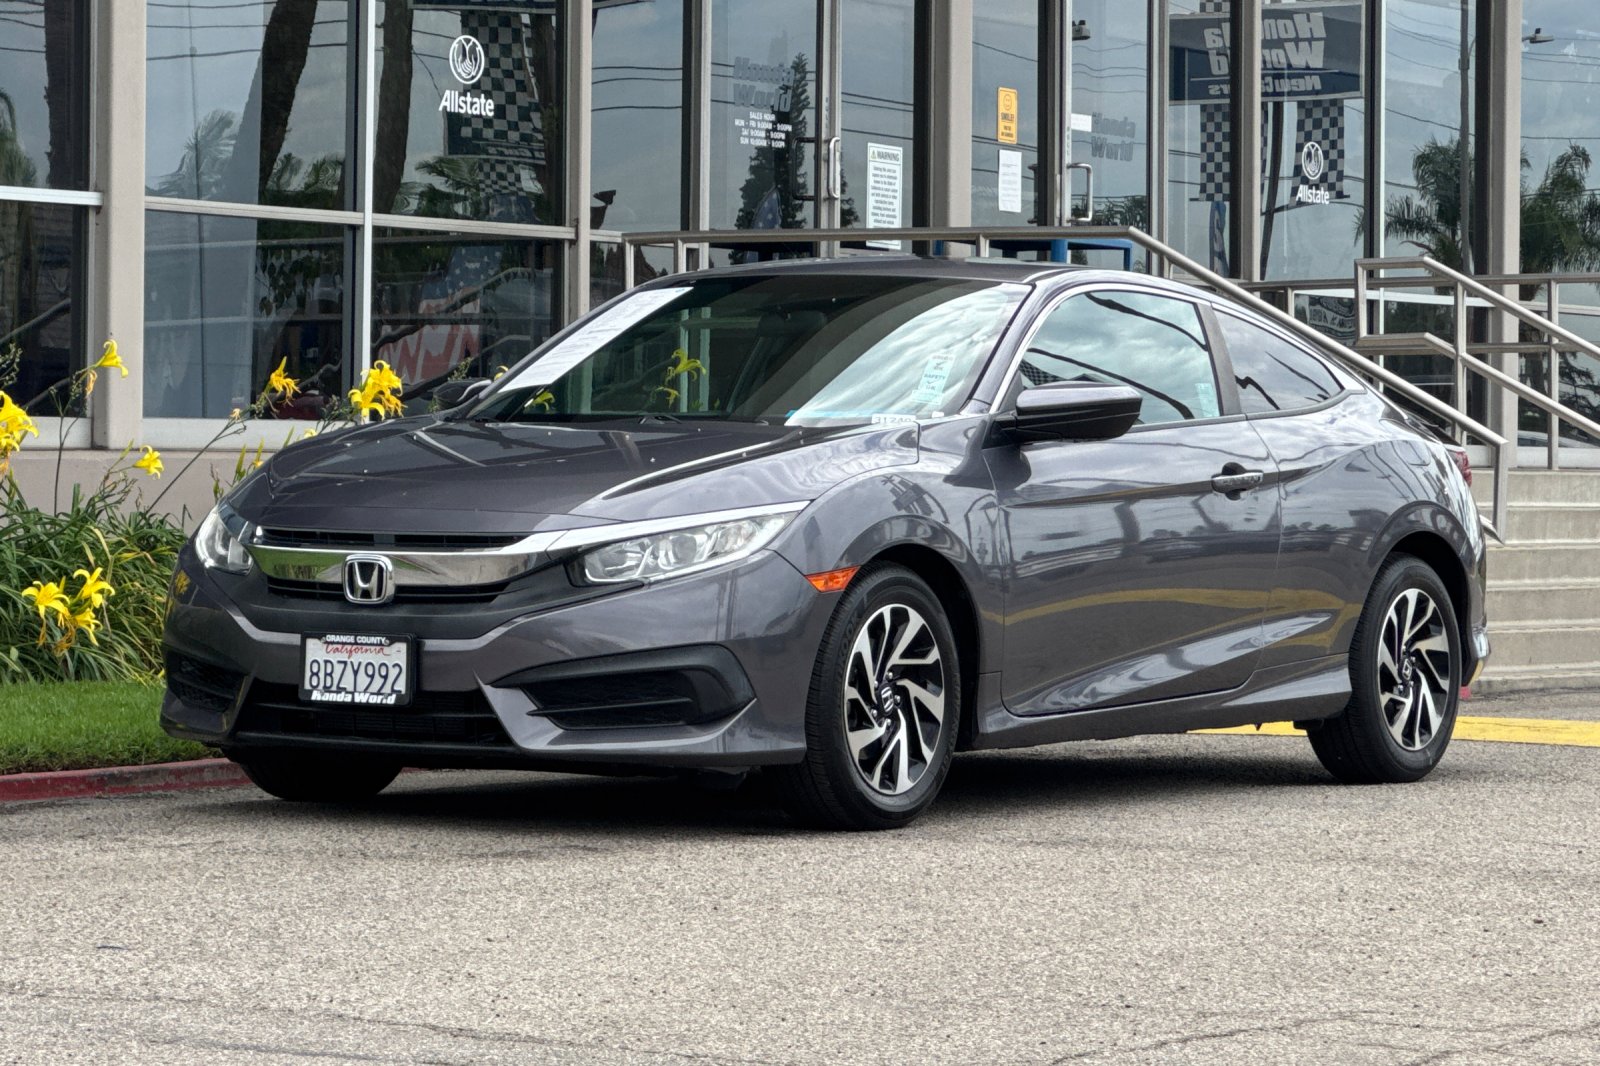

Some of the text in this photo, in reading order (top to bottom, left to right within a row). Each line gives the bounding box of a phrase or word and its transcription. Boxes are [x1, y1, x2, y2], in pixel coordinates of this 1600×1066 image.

[438, 89, 494, 117] Allstate
[877, 151, 900, 162] WARNING
[1296, 184, 1330, 205] Allstate
[326, 635, 386, 645] ORANGE COUNTY
[325, 643, 391, 659] California
[309, 659, 403, 694] 8BZY992
